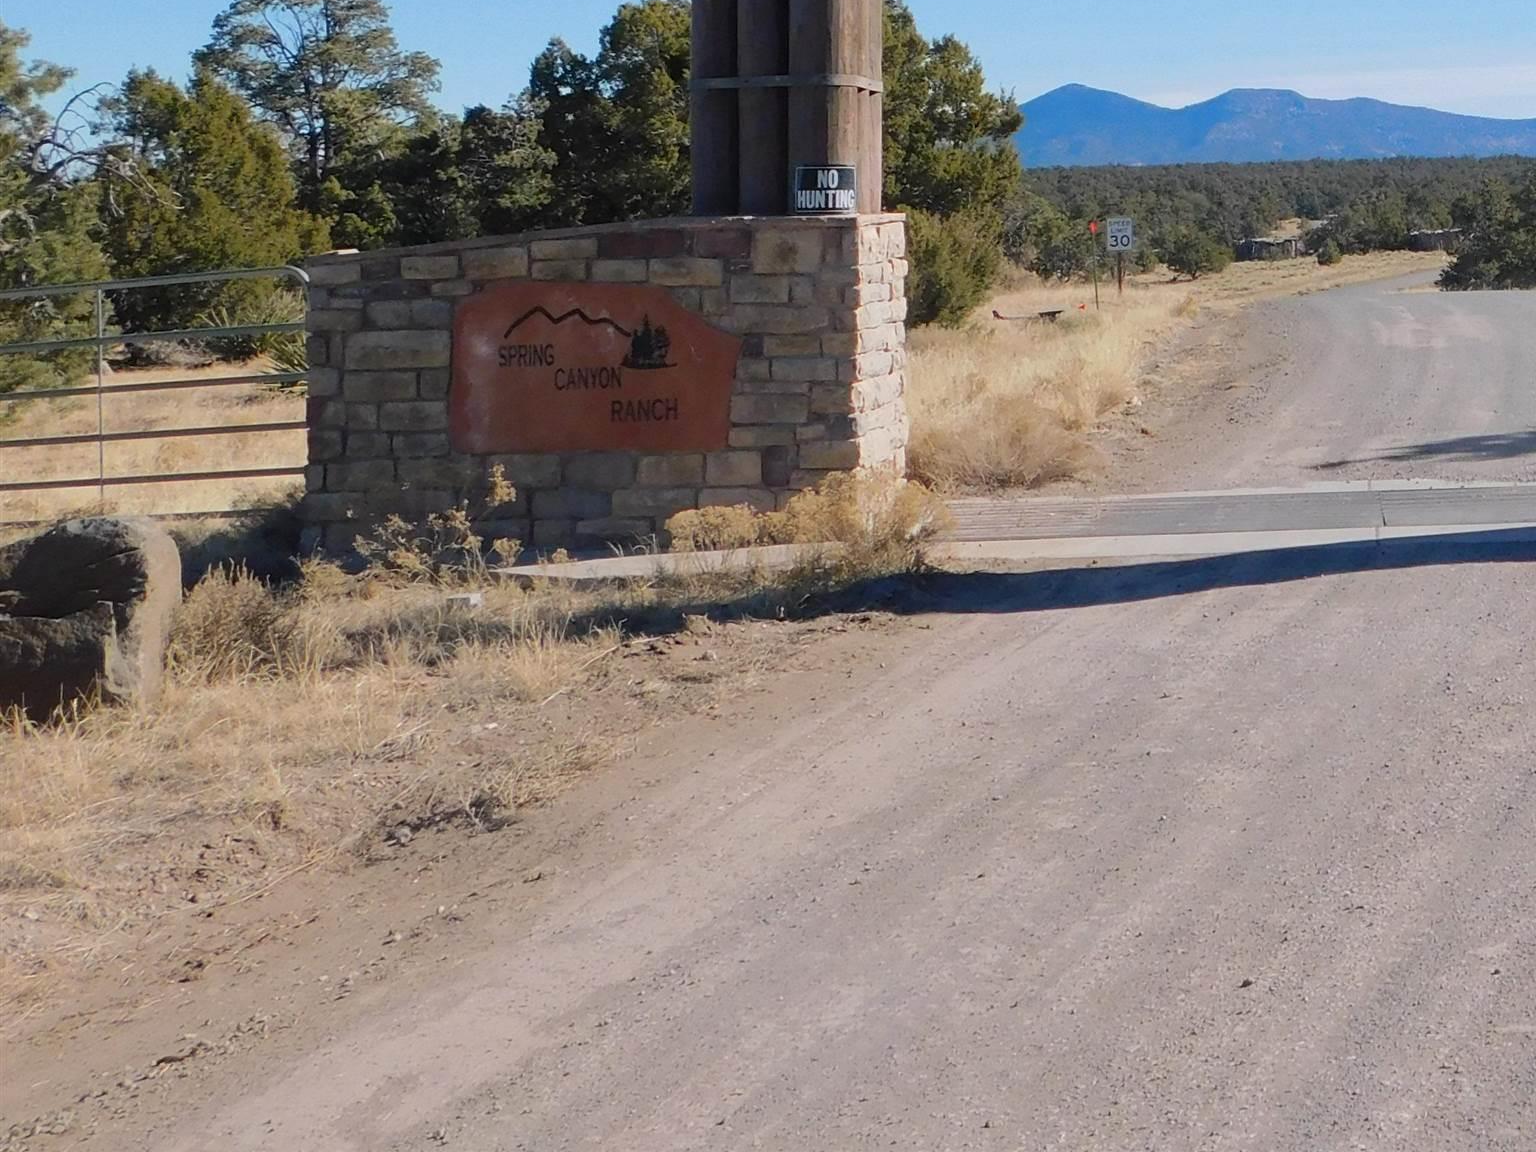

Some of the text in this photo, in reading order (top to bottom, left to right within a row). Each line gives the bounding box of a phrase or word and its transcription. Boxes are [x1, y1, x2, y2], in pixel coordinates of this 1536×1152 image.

[817, 169, 839, 189] NO
[798, 189, 855, 209] HUNTING
[1110, 234, 1130, 247] 30
[497, 344, 556, 368] SPRING
[554, 367, 622, 392] CANYON
[610, 398, 678, 423] RANCH
